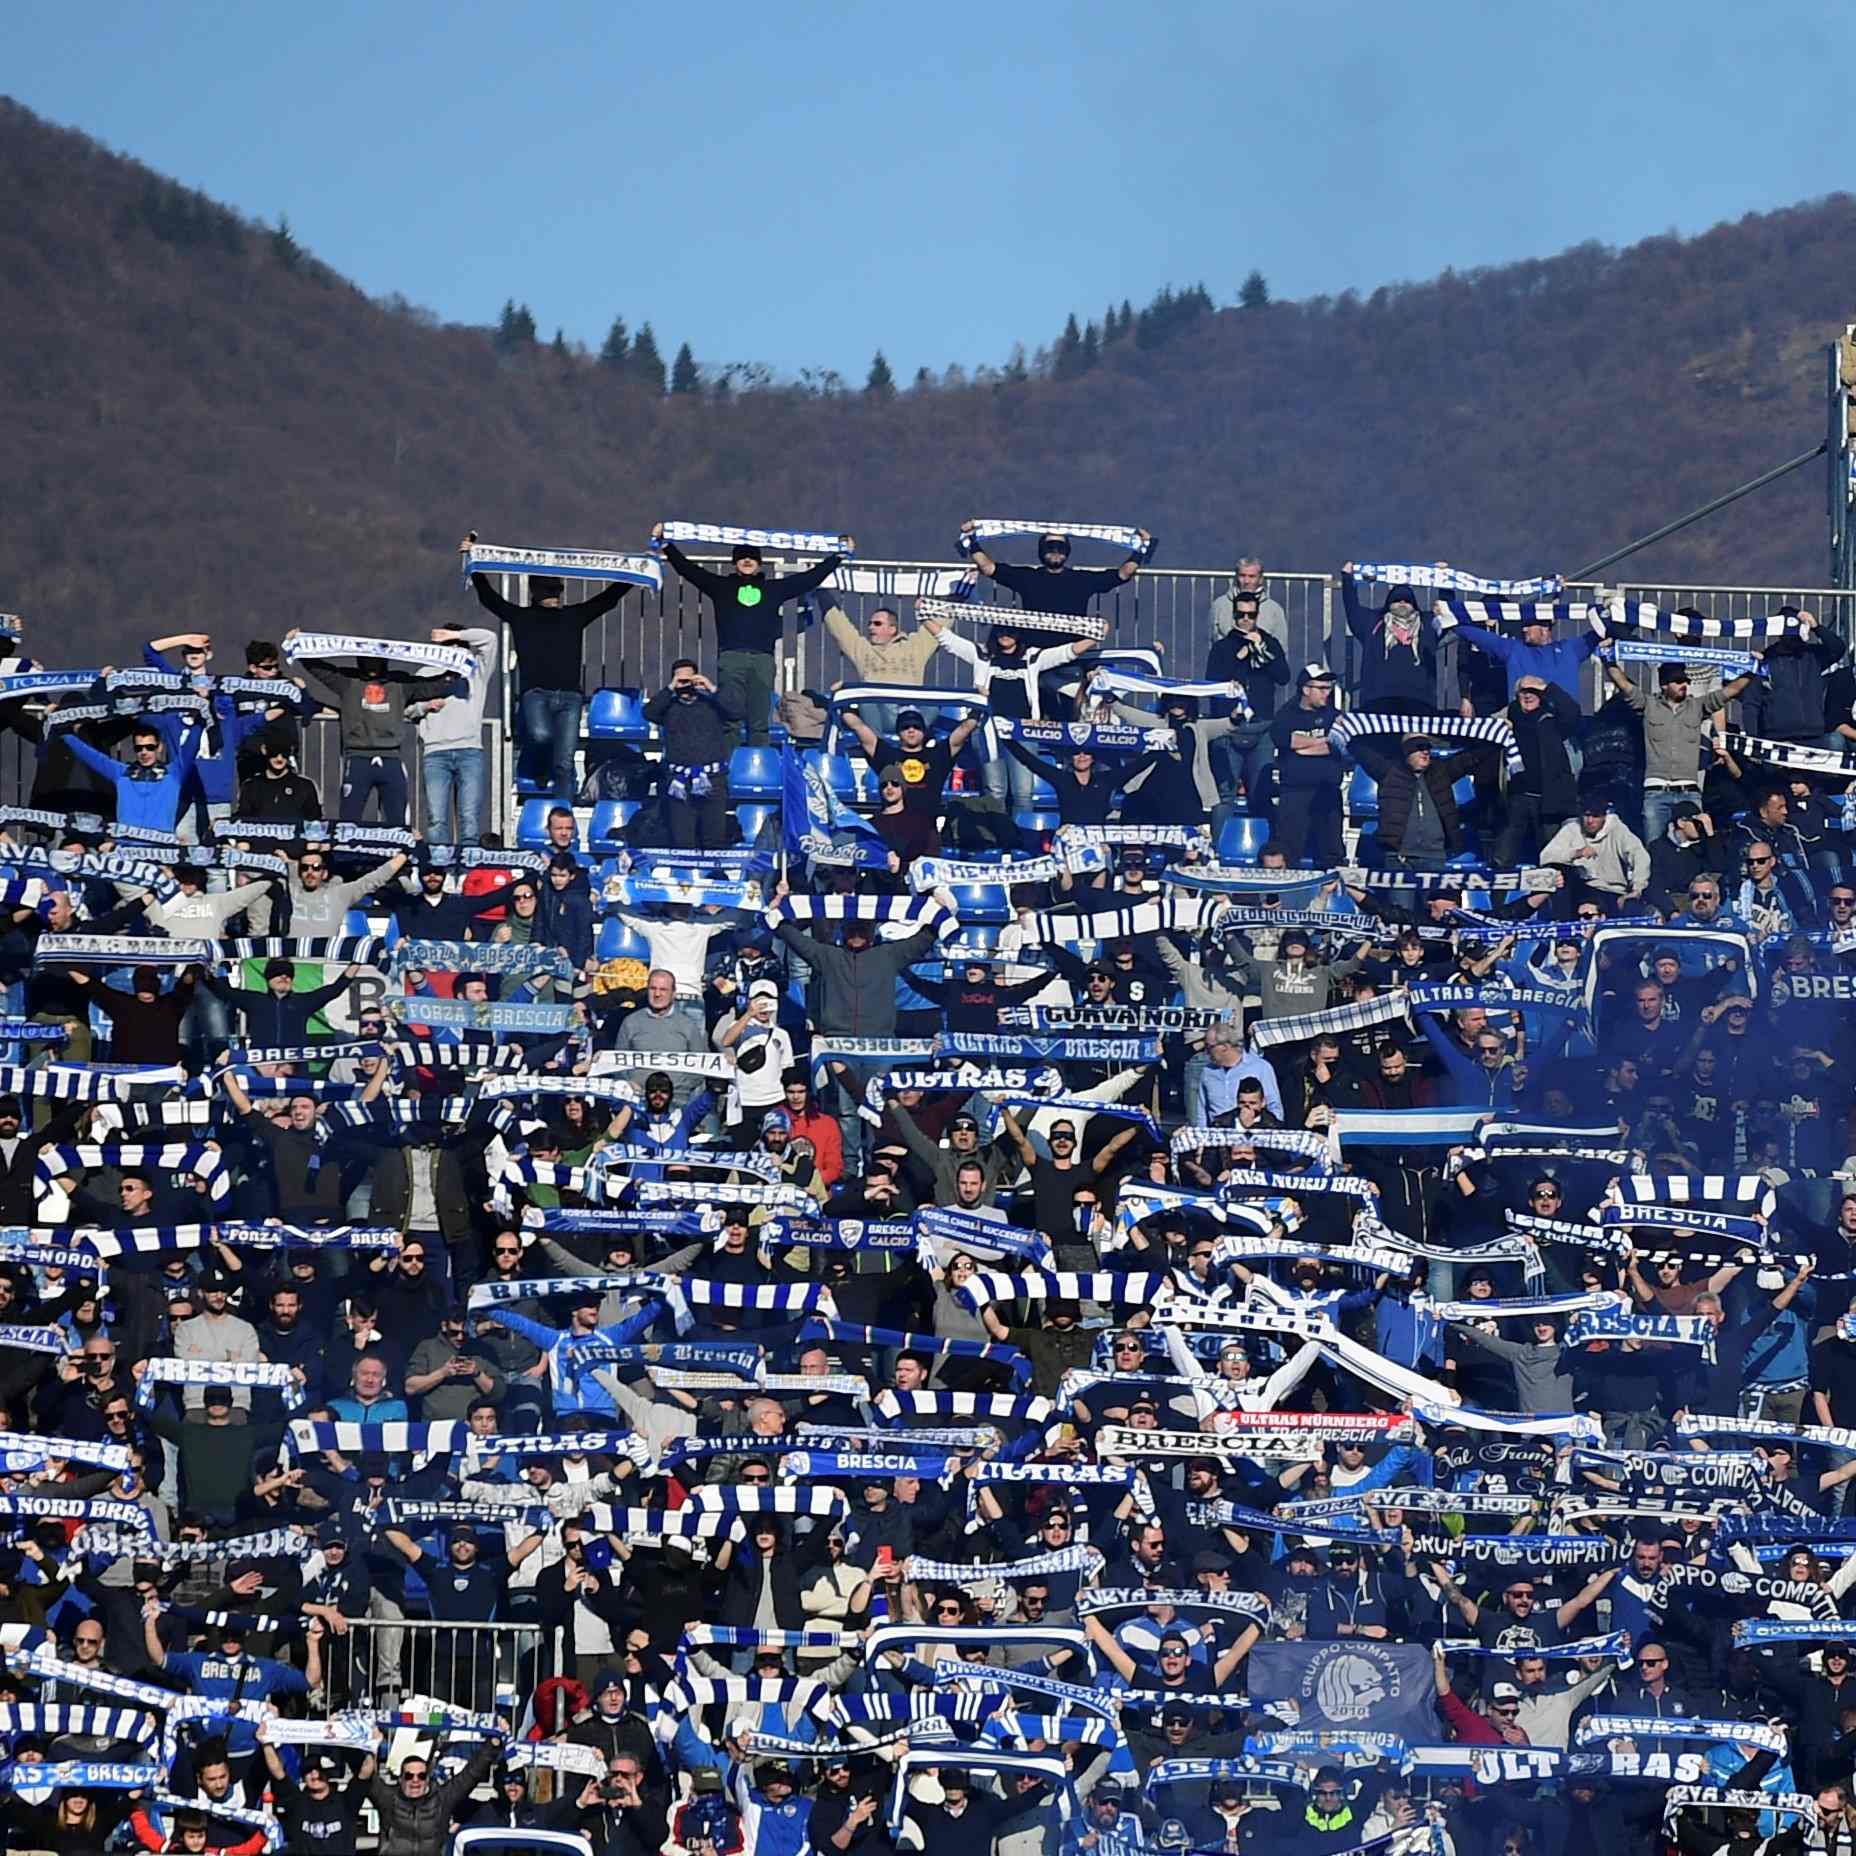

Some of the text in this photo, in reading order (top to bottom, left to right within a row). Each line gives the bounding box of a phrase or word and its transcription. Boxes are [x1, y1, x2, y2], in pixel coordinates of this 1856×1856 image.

[837, 1454, 917, 1471] BRESCIA
[1477, 1752, 1700, 1783] ULT RAS
